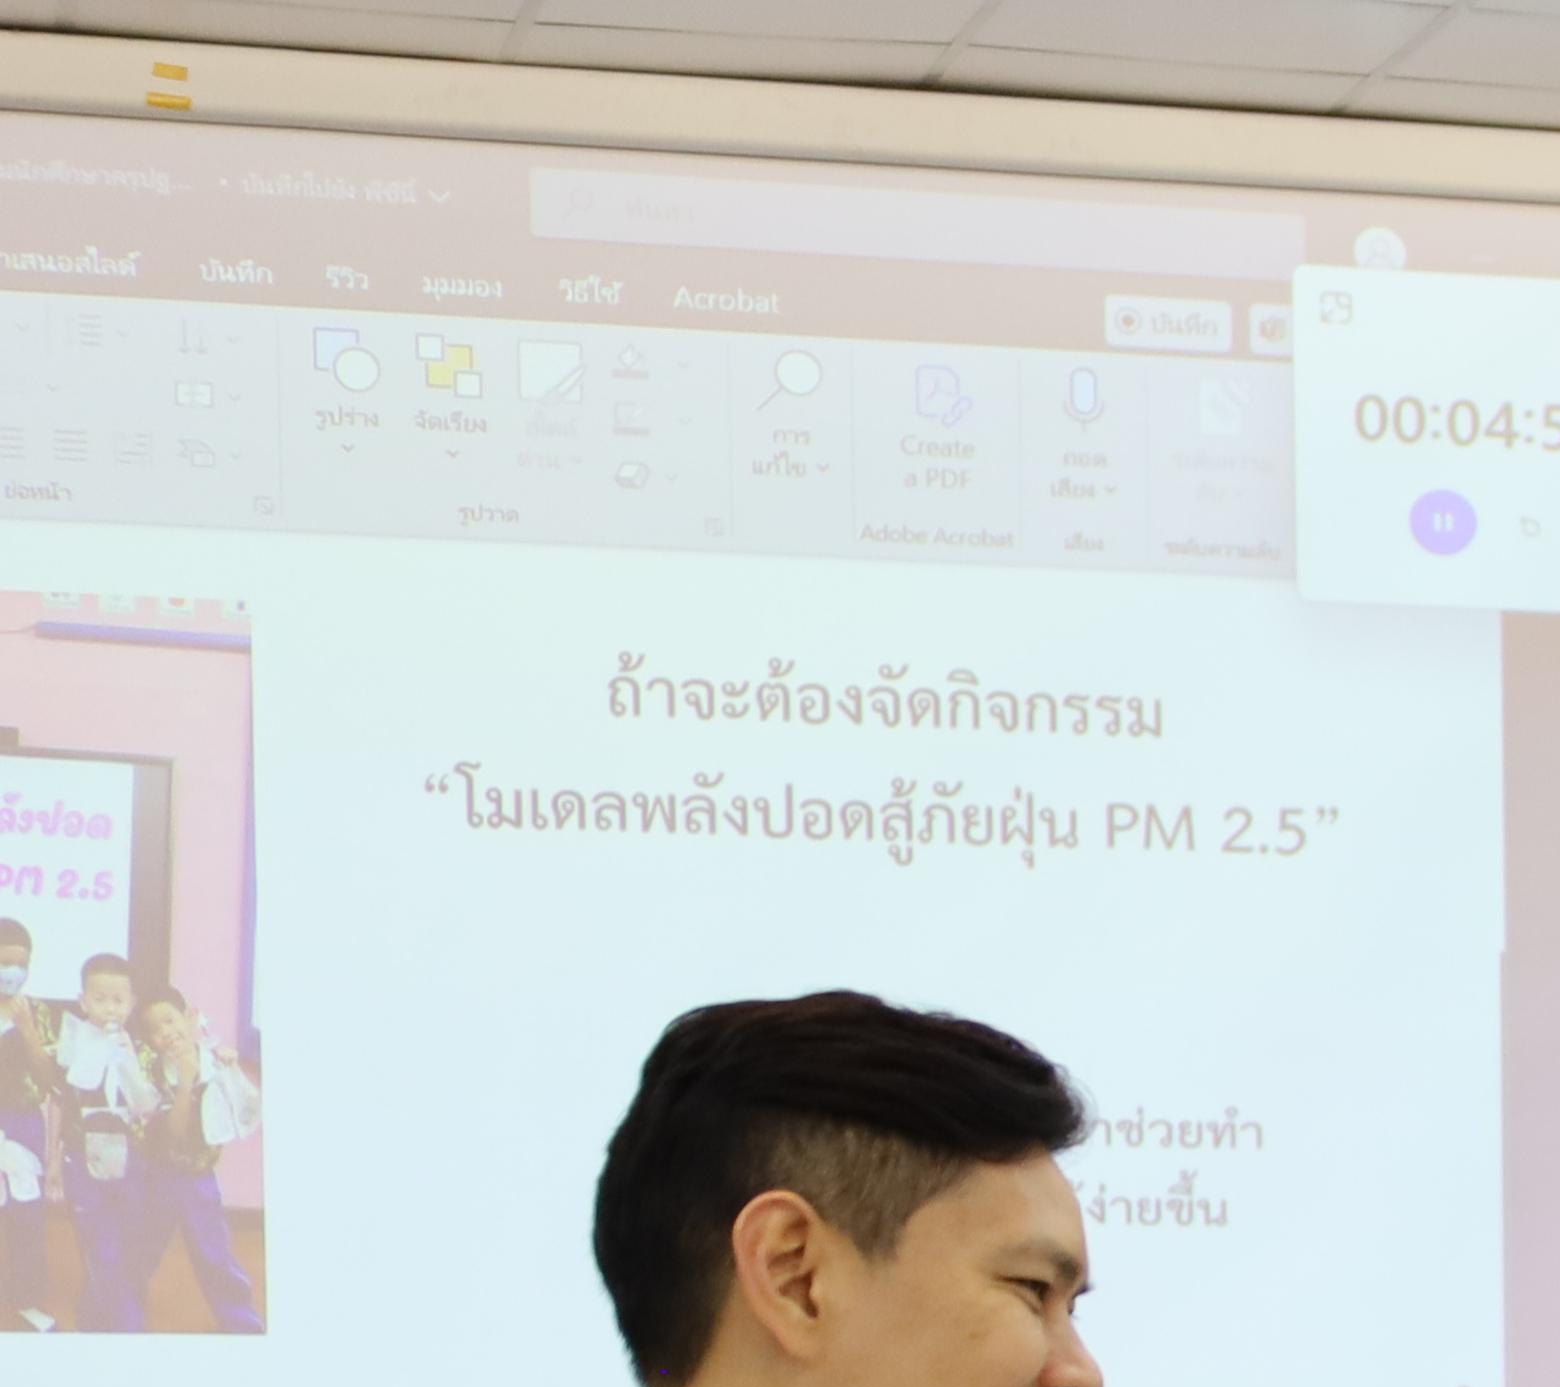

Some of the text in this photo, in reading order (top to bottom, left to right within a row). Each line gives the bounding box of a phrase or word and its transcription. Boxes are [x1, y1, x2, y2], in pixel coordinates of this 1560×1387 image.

[200, 257, 274, 286] บันทึก
[422, 273, 503, 302] มุมมอง
[673, 284, 782, 314] Acrobat
[899, 434, 976, 460] Create
[903, 466, 973, 491] a PDF
[860, 523, 1015, 551] Adobe Acrobat
[607, 651, 1163, 739] ถ้าจะต้องจัดกิจกรรม
[1105, 801, 1197, 852] PM
[55, 869, 114, 901] 2.5
[1088, 1105, 1263, 1150] าช่วยทำ
[1086, 1168, 1228, 1227] ง่ายขึ้น
